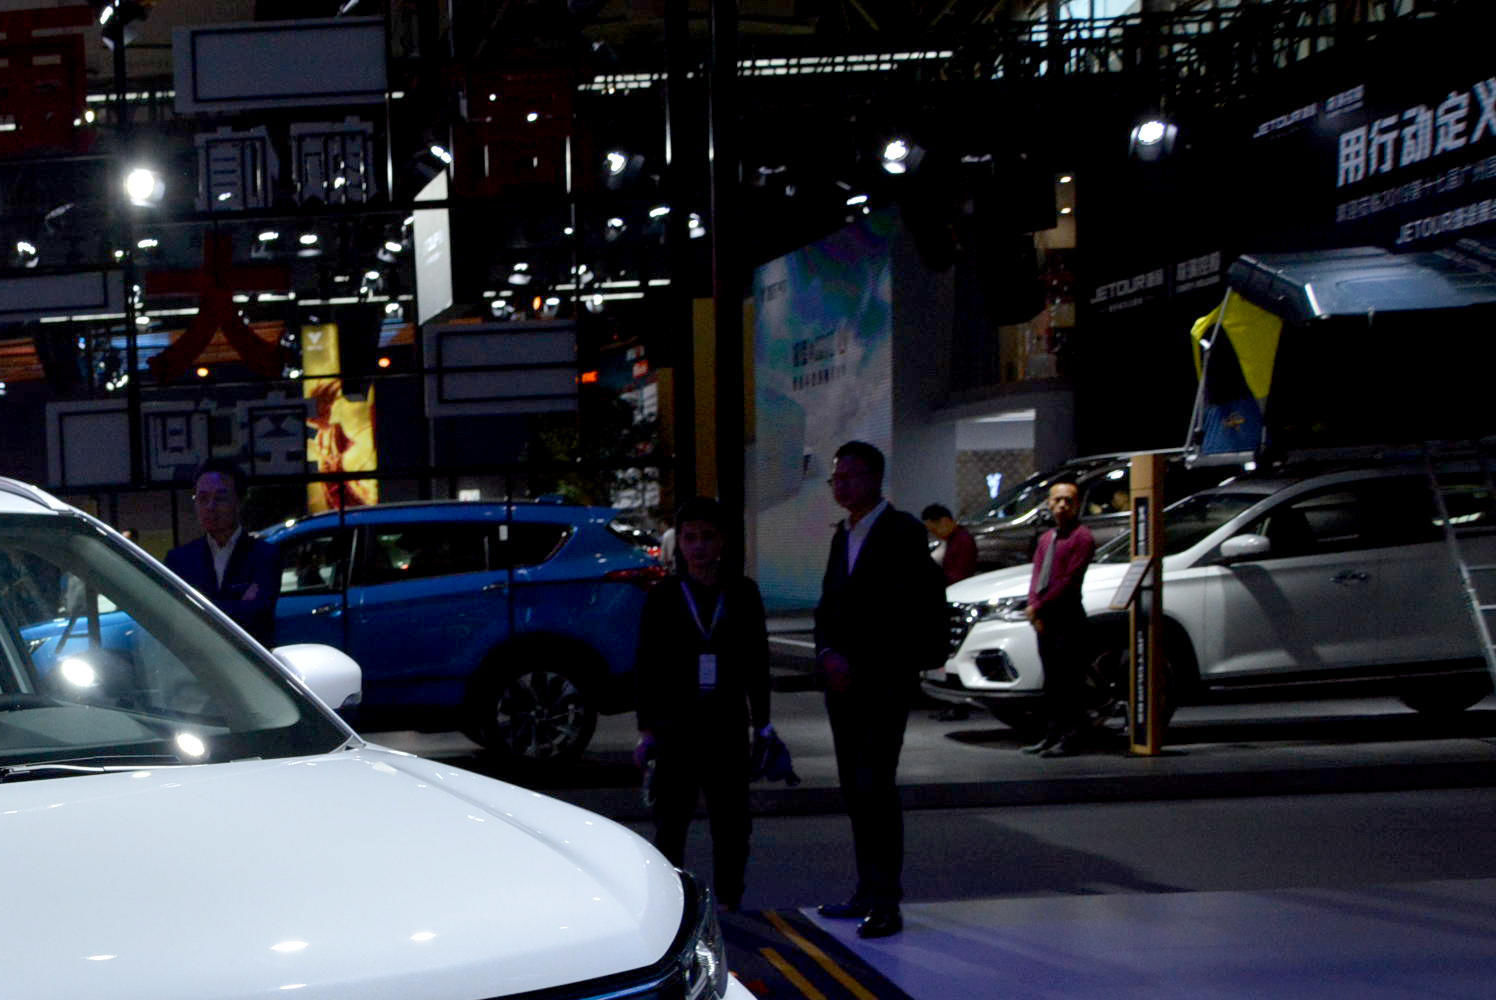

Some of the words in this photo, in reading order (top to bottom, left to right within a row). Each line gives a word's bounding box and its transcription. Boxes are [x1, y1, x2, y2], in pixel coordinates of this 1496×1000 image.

[1336, 77, 1496, 188] 用行动定义
